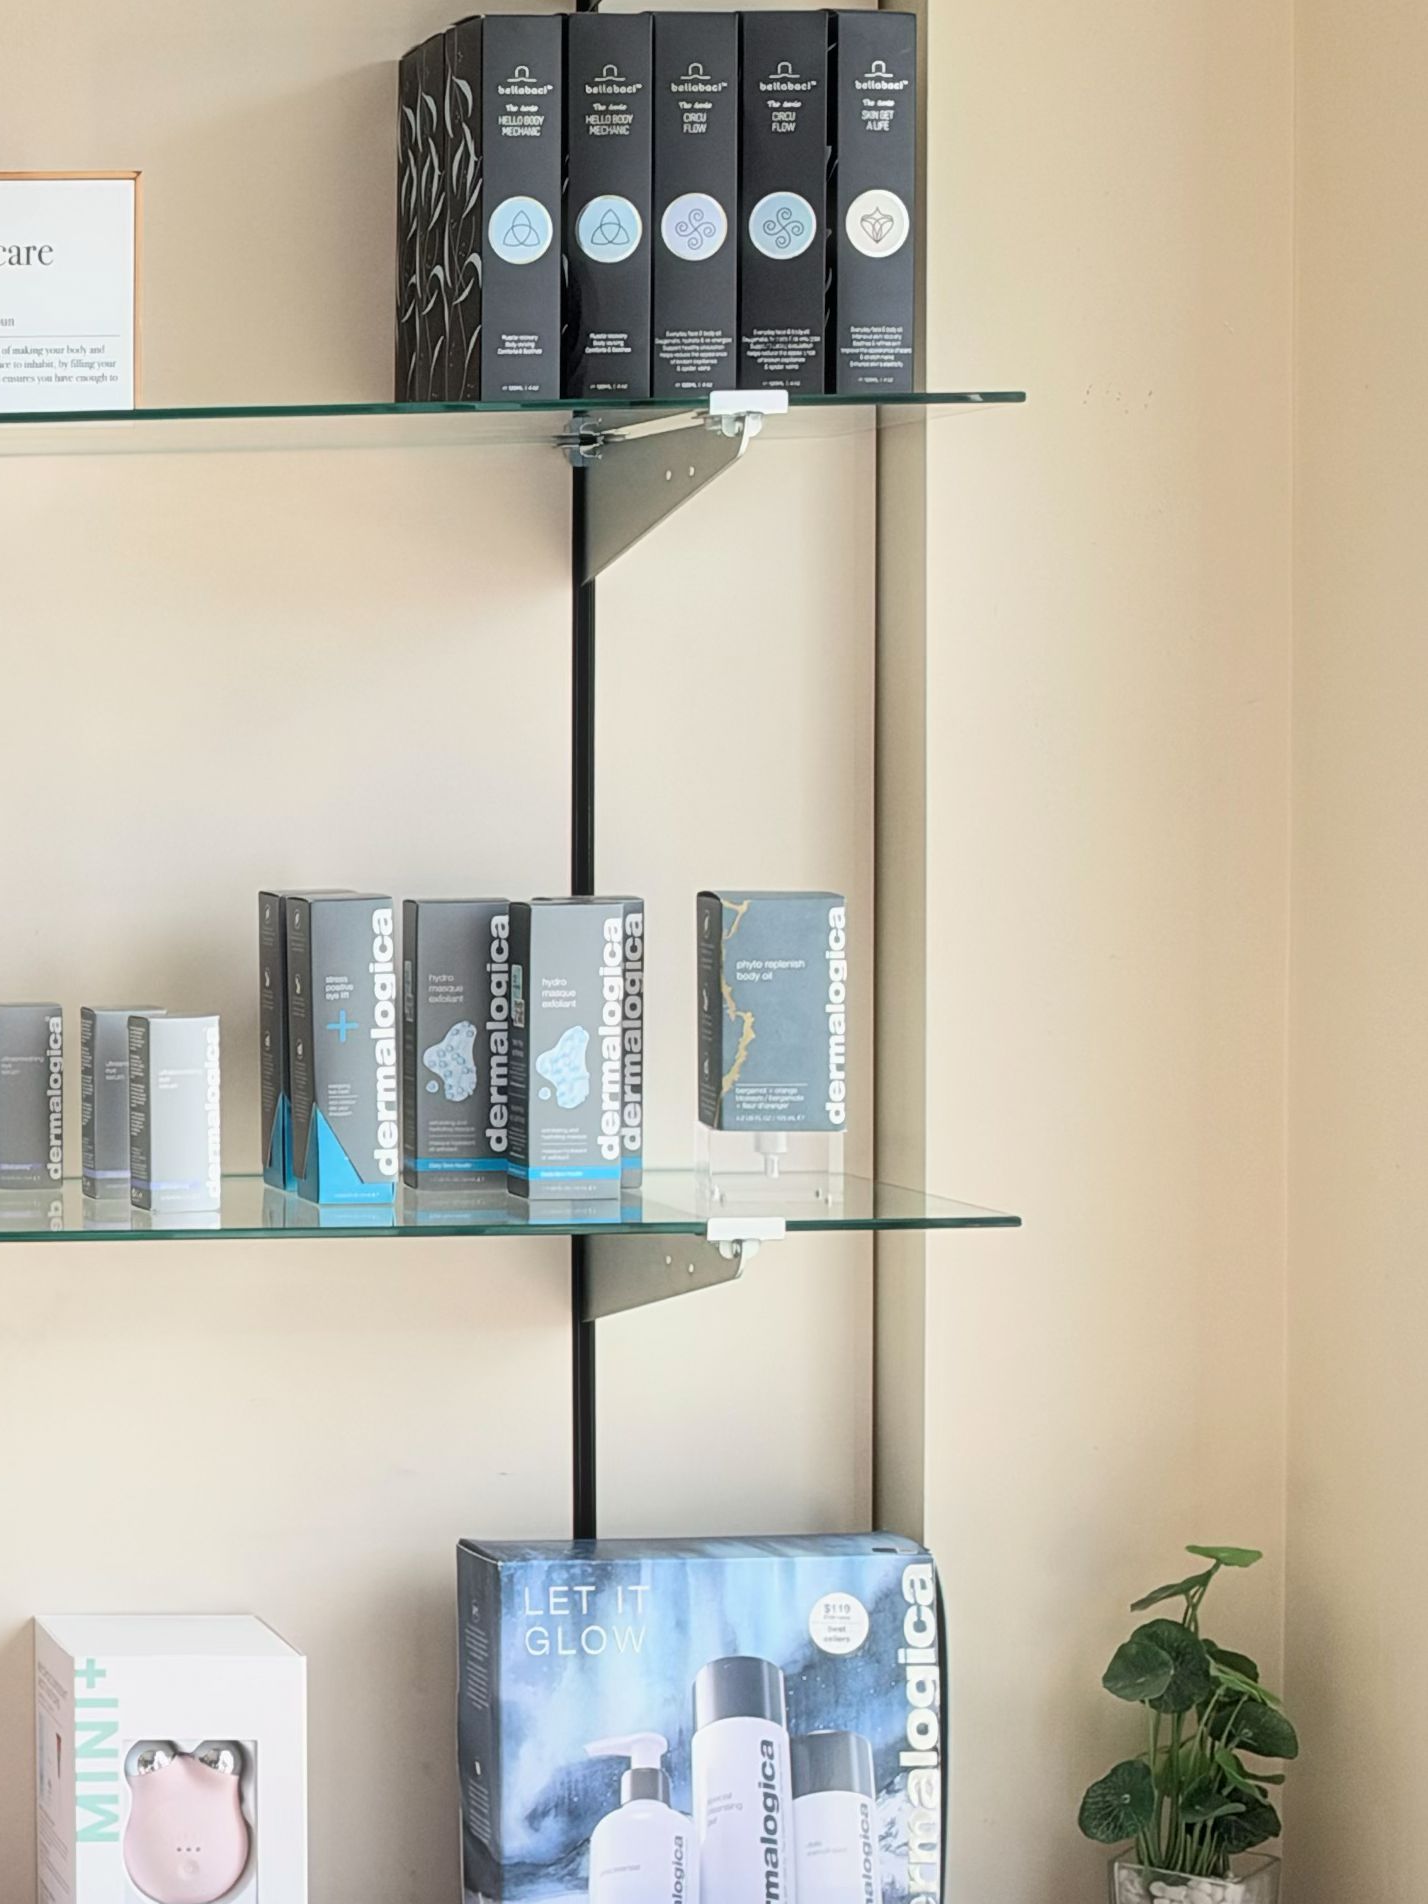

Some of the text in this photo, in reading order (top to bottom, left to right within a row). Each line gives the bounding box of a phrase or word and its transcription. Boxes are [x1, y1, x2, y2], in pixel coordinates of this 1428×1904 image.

[369, 907, 399, 1176] dermalogica
[485, 914, 510, 1153] dermalogica
[597, 916, 624, 1162] dermalogica
[736, 959, 805, 971] phyto replenish
[736, 971, 773, 983] body oil
[825, 906, 847, 1125] dermalogica
[45, 1016, 64, 1180] dermalogica
[523, 1584, 651, 1617] LET IT
[523, 1624, 647, 1656] GLOW
[74, 1658, 120, 1843] MINI+
